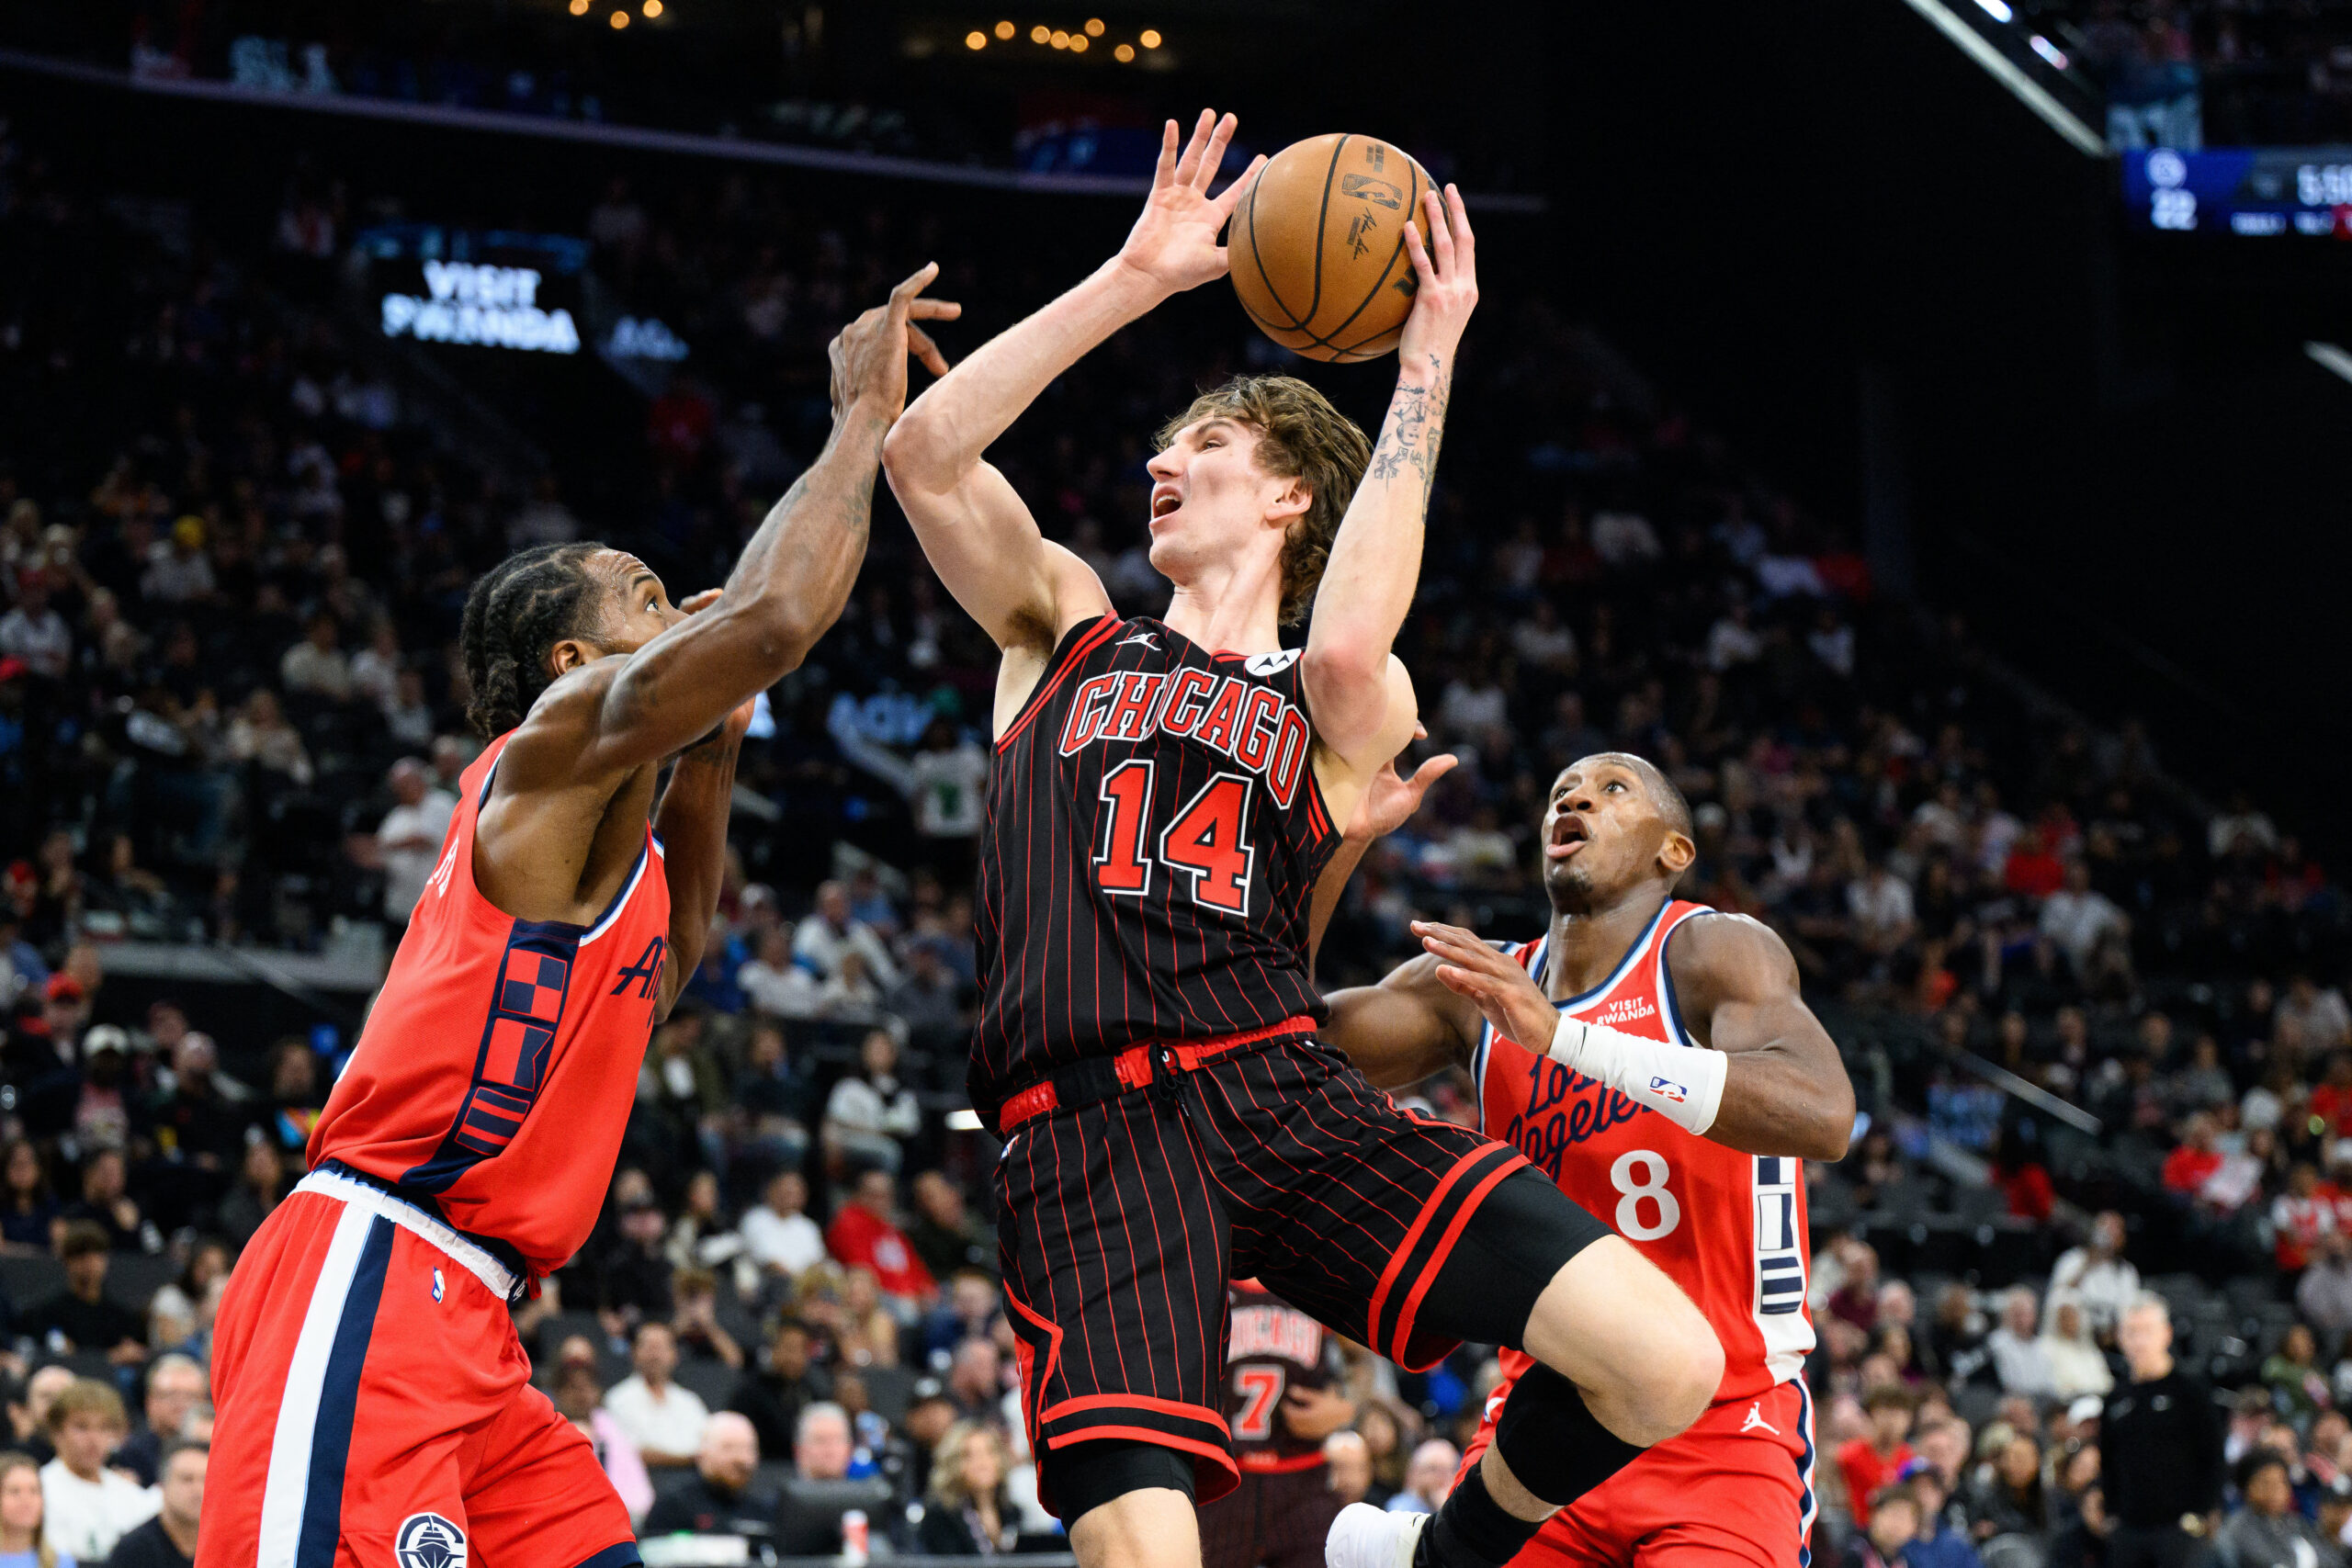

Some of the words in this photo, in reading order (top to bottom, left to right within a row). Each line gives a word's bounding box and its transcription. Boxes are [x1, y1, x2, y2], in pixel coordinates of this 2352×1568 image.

[1058, 663, 1310, 810] CHICAGO
[1092, 759, 1255, 918] 14
[1596, 1004, 1656, 1026] RWANDA
[1608, 996, 1644, 1012] VISIT
[1506, 1080, 1653, 1184] Angele
[1610, 1149, 1680, 1240] 8
[1231, 1363, 1285, 1441] 7
